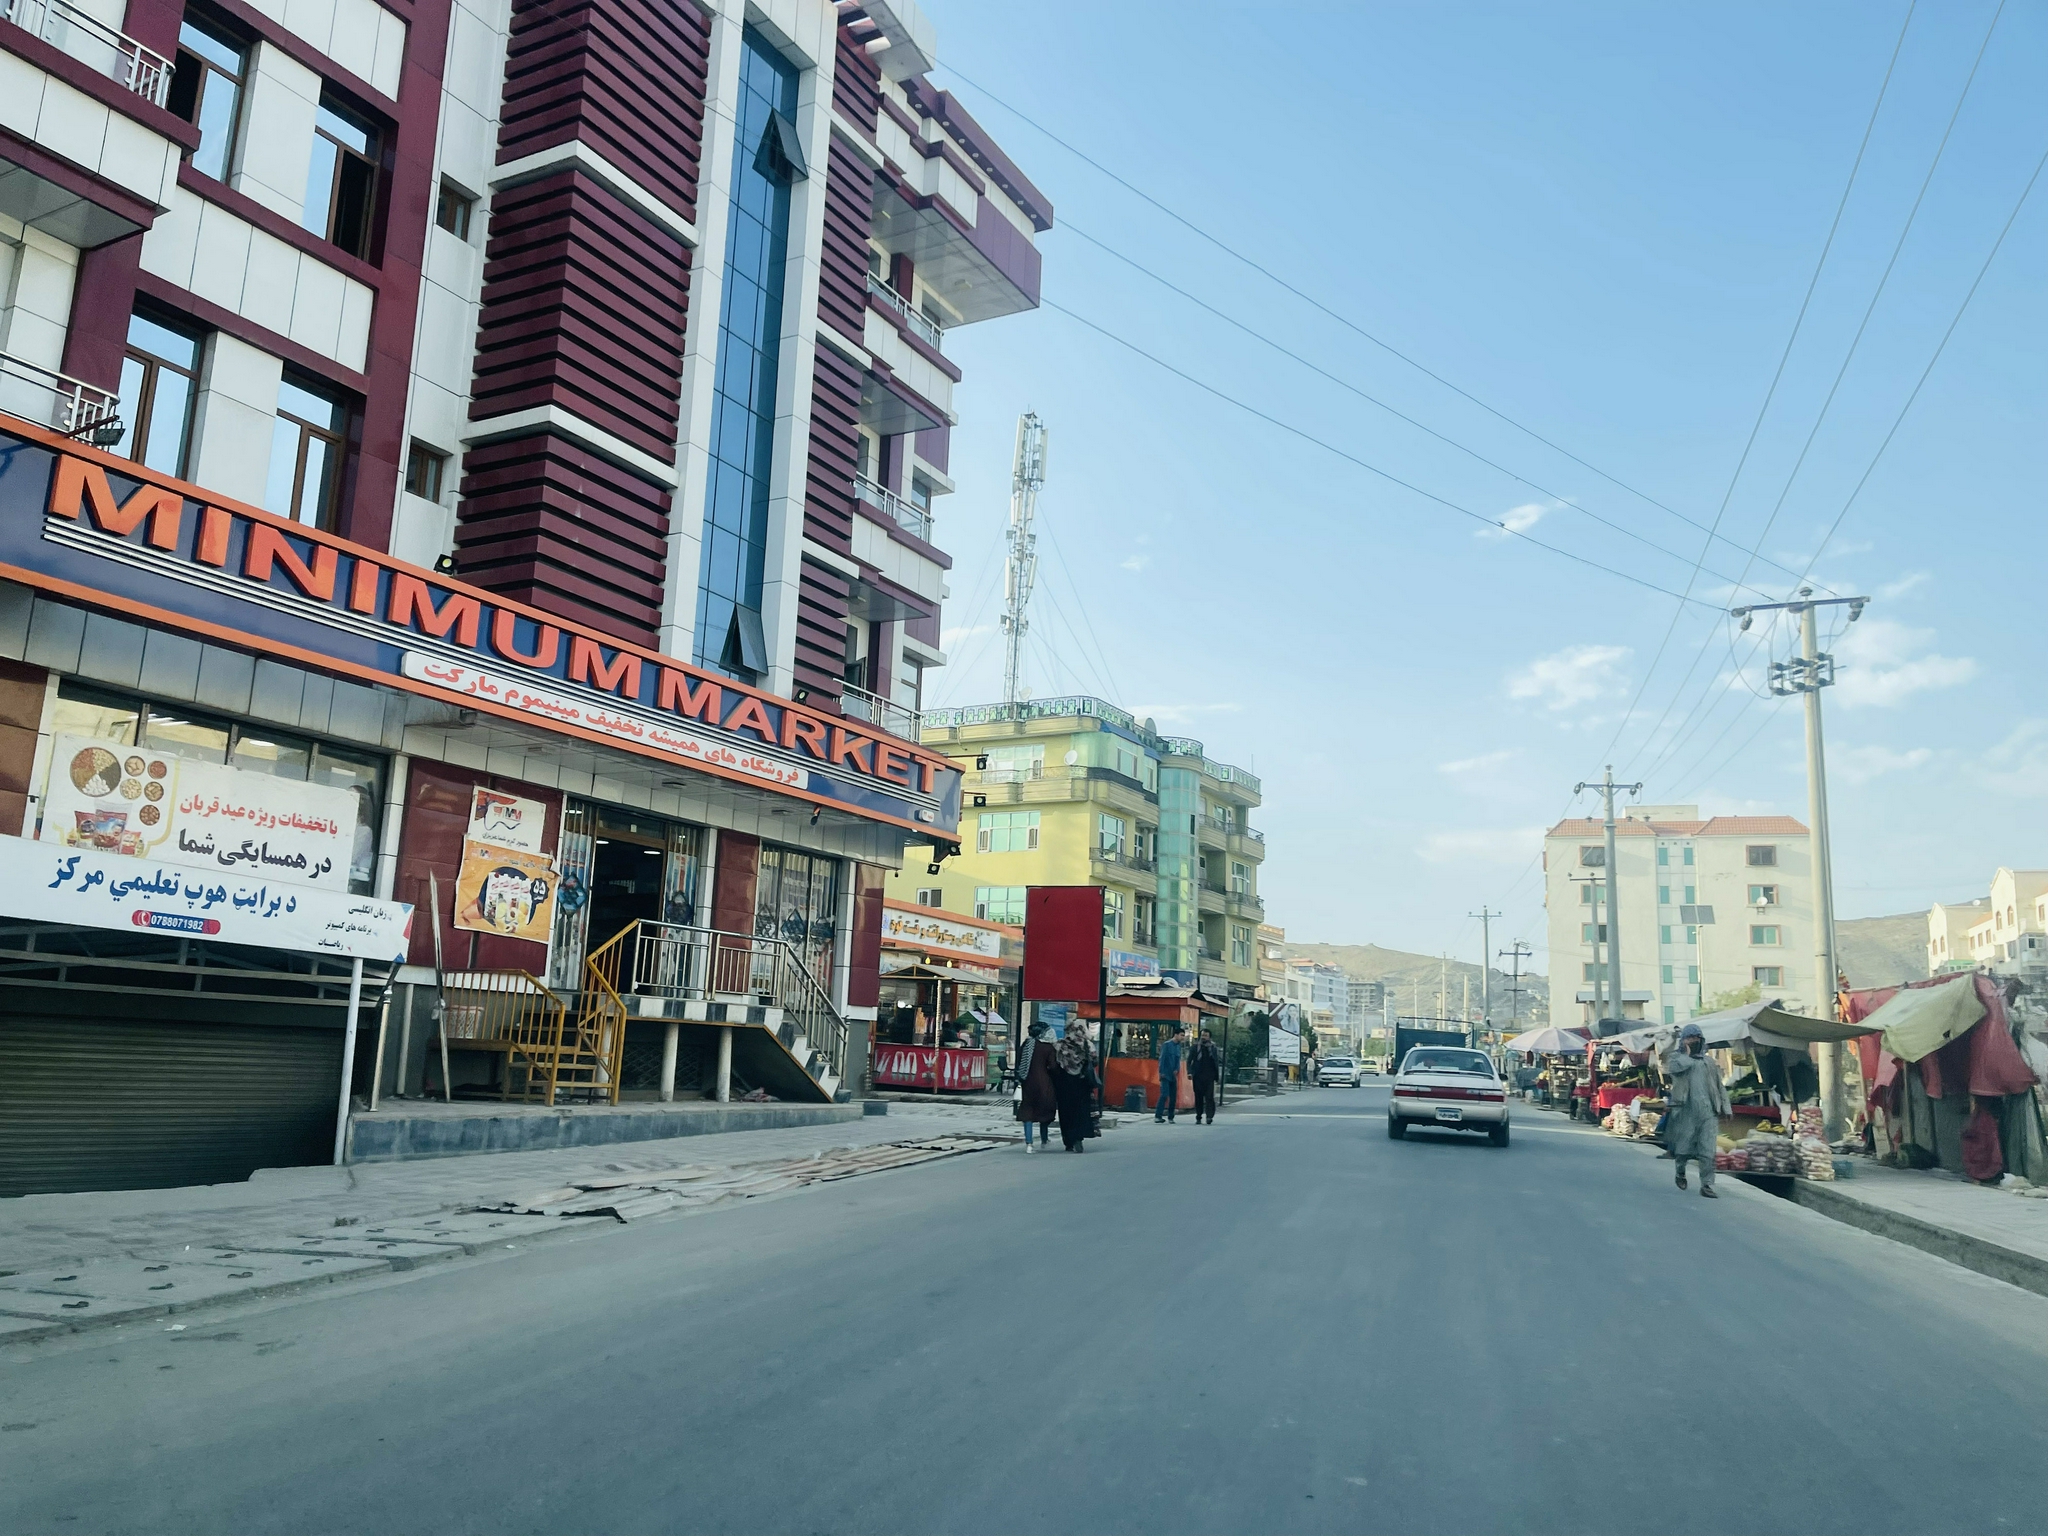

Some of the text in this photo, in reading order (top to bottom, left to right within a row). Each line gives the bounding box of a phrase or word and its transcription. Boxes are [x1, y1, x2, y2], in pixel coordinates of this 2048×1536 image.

[424, 662, 799, 784] فروشگاه های همیشه تخفیف مینیموم مارکت
[180, 793, 338, 839] با تخفیفات ویژه عید قربان
[48, 855, 105, 892] مرکز
[178, 827, 332, 879] در همسایگی شما
[184, 881, 227, 910] هوپ
